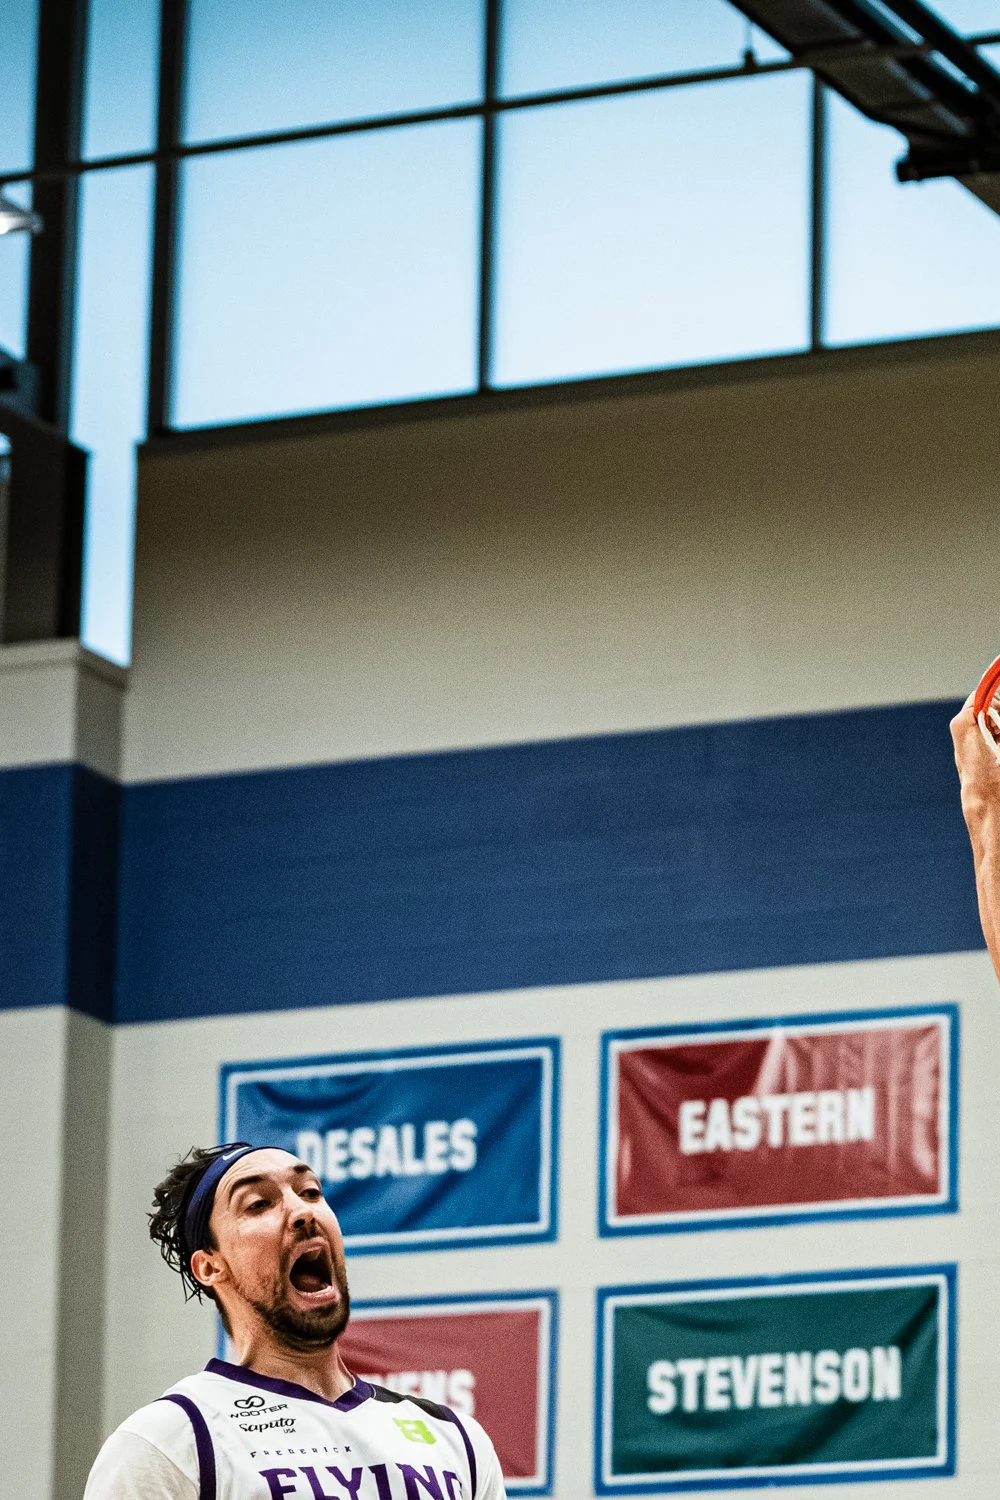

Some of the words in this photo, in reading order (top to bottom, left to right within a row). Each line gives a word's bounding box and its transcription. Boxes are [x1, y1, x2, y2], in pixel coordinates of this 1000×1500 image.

[679, 1087, 876, 1155] EASTERN
[298, 1119, 478, 1183] DESALES
[647, 1345, 901, 1416] STEVENSON
[230, 1403, 288, 1419] WOOTER
[239, 1417, 296, 1433] Saputo
[250, 1446, 352, 1459] FREDERICK
